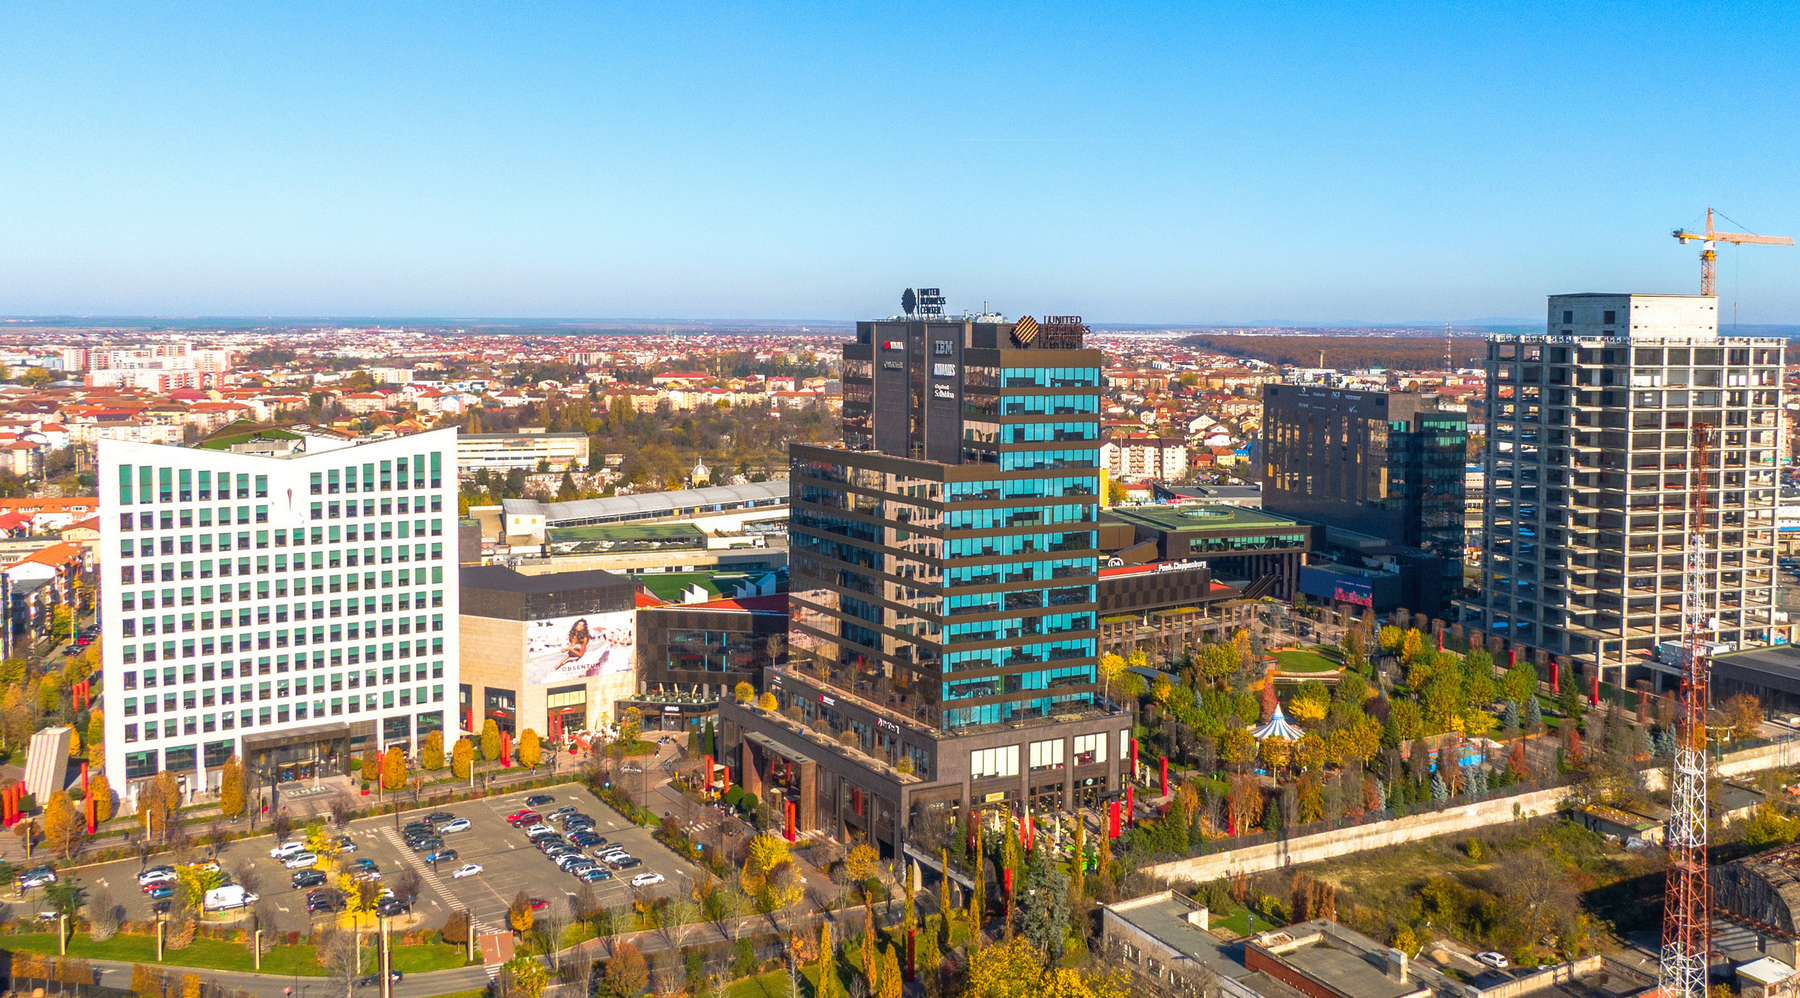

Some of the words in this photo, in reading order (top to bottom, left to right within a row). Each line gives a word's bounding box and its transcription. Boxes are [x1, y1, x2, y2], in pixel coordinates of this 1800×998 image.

[1047, 315, 1082, 324] UNITED
[935, 340, 953, 355] IBM
[562, 662, 600, 672] OBSENTUM
